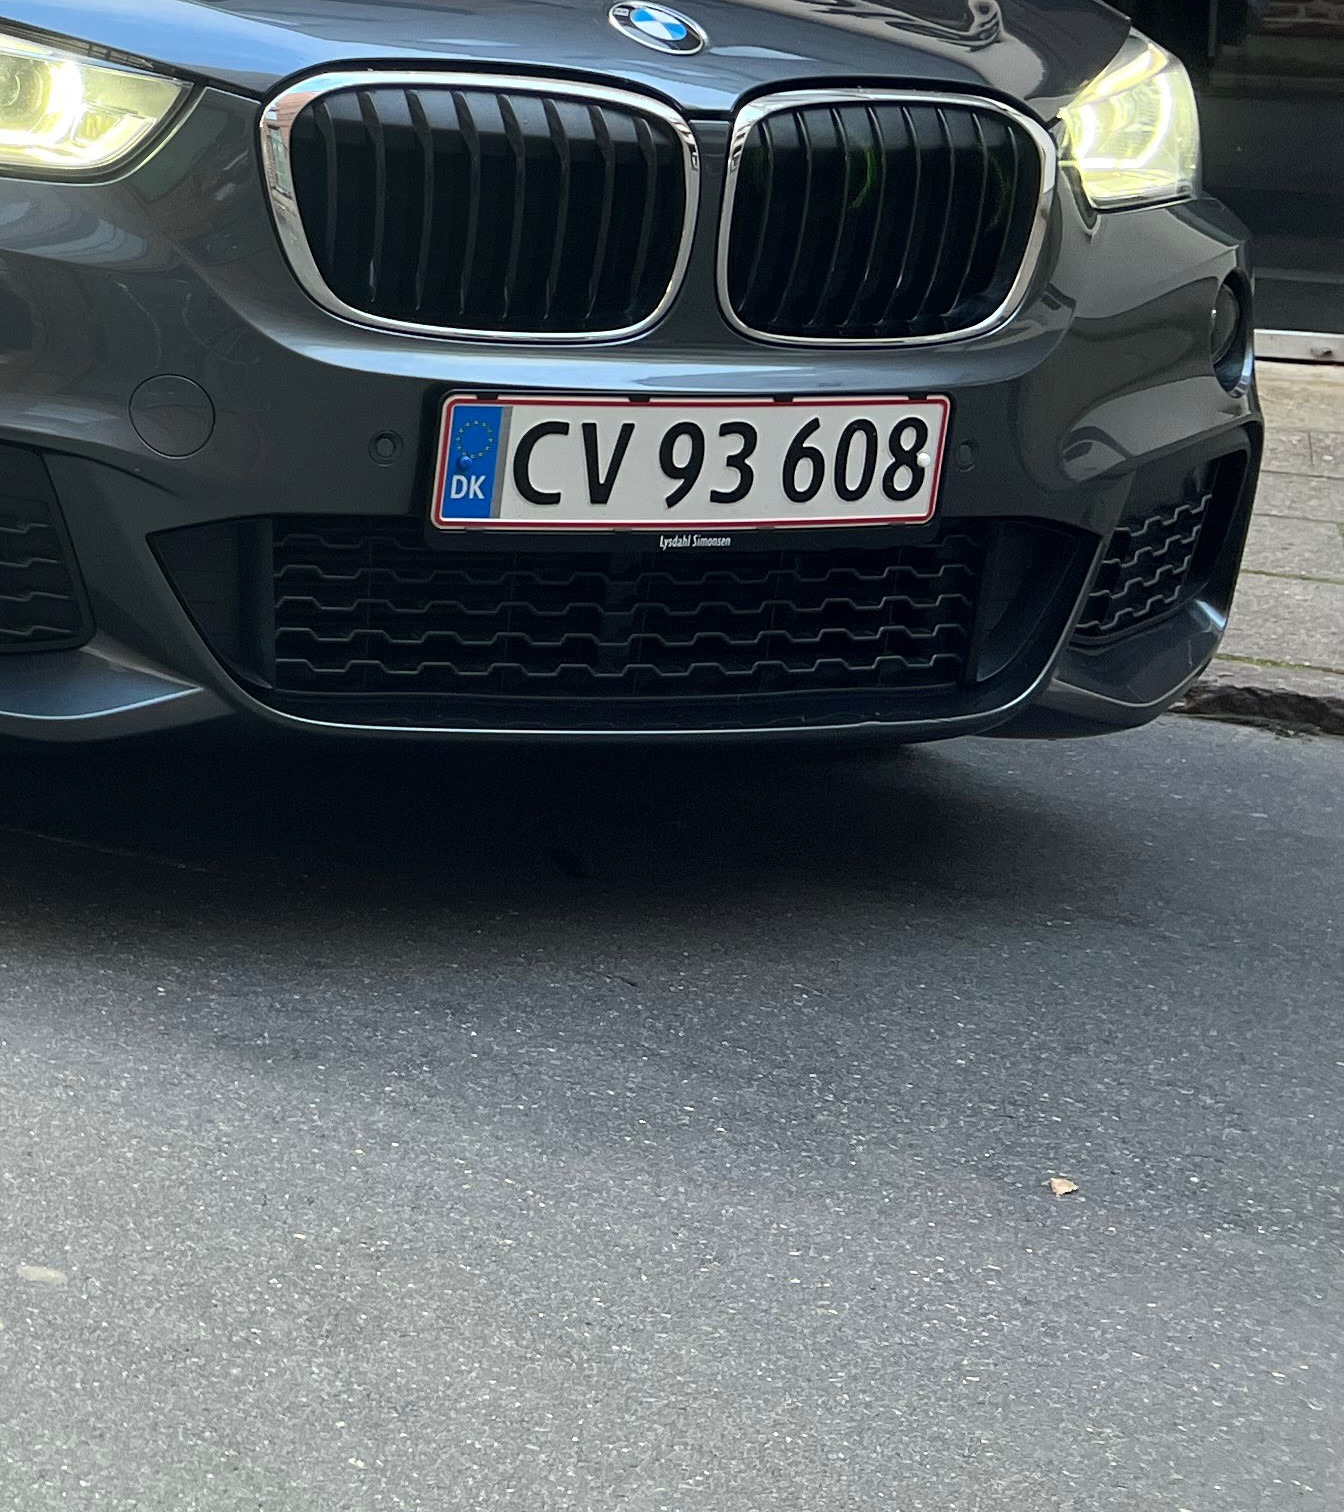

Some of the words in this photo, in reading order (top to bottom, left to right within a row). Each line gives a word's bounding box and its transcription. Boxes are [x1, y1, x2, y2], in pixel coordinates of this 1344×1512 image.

[450, 474, 485, 501] DK
[513, 421, 635, 506] CV
[658, 421, 758, 508] 93
[782, 418, 930, 504] 608
